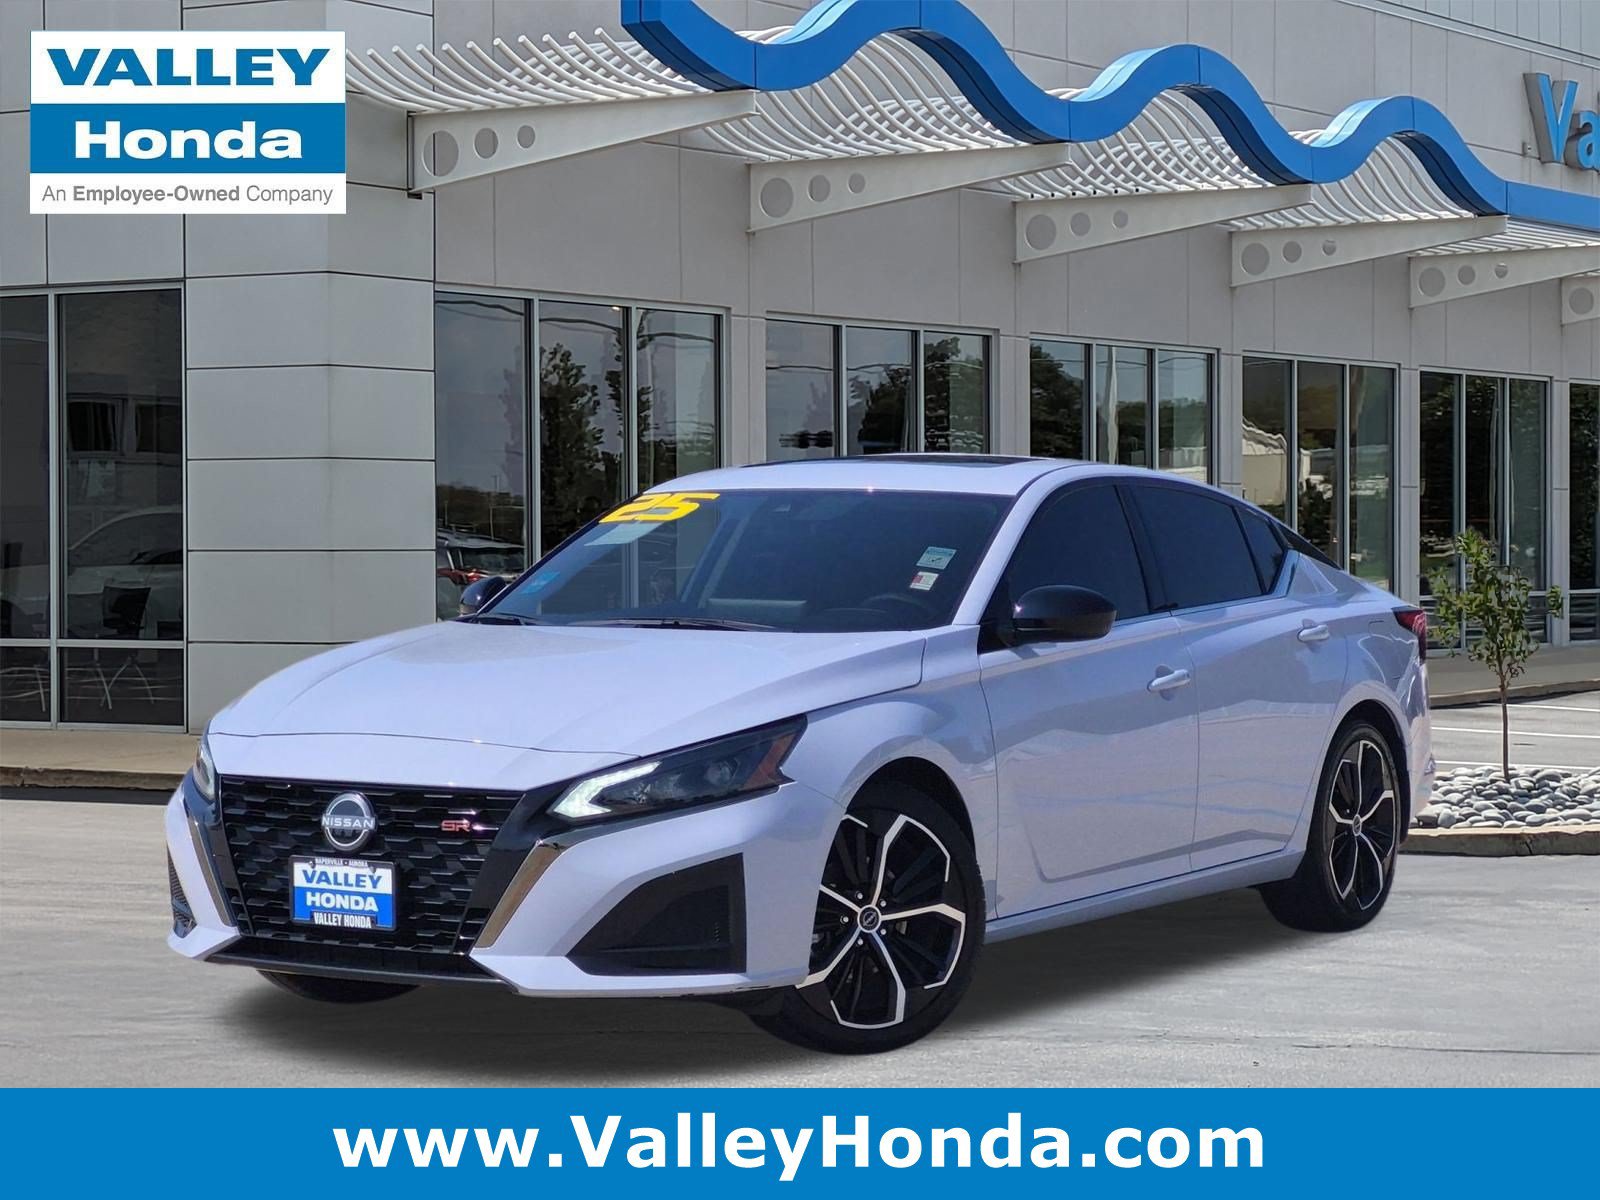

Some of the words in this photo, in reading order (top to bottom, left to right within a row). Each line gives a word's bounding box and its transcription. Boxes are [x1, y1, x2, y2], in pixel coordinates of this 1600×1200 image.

[1523, 71, 1600, 170] Va
[599, 492, 721, 523] 25
[322, 816, 376, 829] NISSAN
[441, 819, 471, 832] SR
[302, 869, 382, 889] VALLEY
[306, 891, 379, 912] HONDA
[313, 912, 343, 927] VALLEY
[343, 914, 372, 929] HONDA
